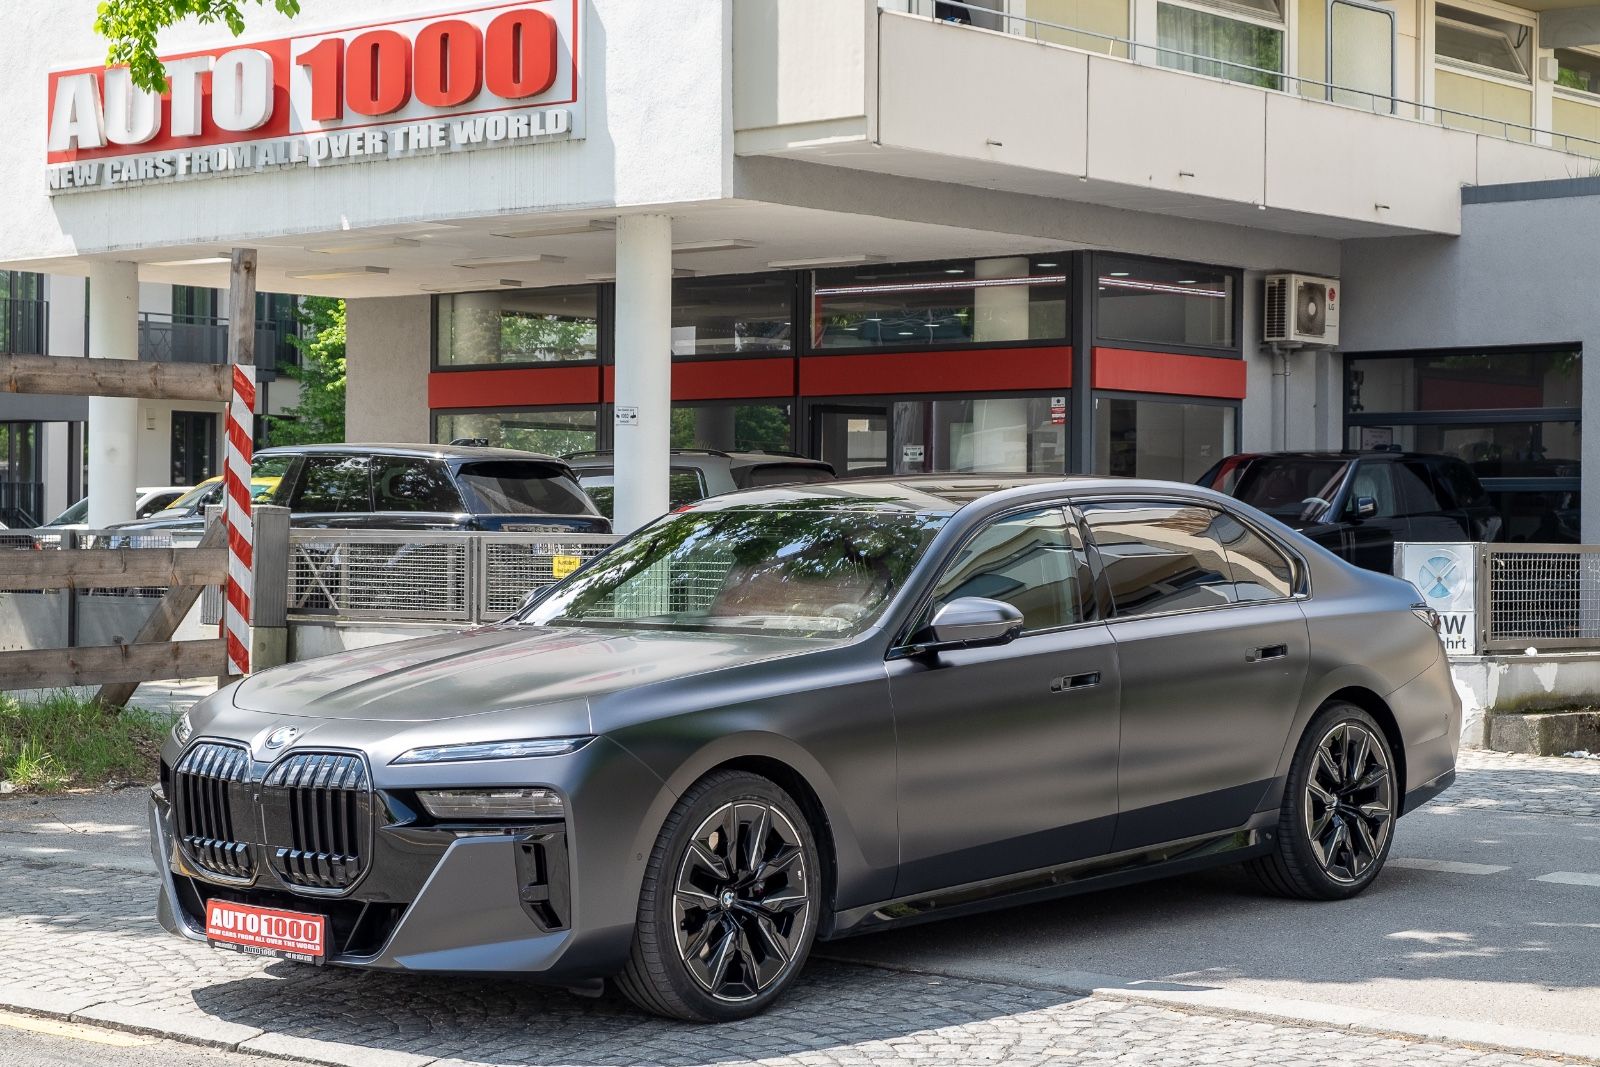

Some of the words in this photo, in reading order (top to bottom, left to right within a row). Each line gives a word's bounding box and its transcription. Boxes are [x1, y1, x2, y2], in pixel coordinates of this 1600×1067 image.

[48, 49, 274, 152] AUTO
[296, 8, 557, 121] 1000
[46, 164, 100, 189] NEW
[103, 153, 177, 183] CARS
[177, 146, 251, 176] FROM
[257, 139, 307, 166] ALL
[309, 130, 388, 160] OVER
[391, 122, 448, 151] THE
[453, 109, 572, 144] WORLD
[1439, 614, 1467, 634] W
[1446, 637, 1467, 649] hrt
[210, 907, 259, 933] AUTO
[263, 918, 317, 941] 1000
[221, 930, 237, 938] CARS
[237, 932, 255, 941] FROM
[266, 938, 282, 946] OVER
[283, 940, 295, 948] THE
[296, 942, 320, 951] WORLD
[244, 946, 260, 954] AUTO
